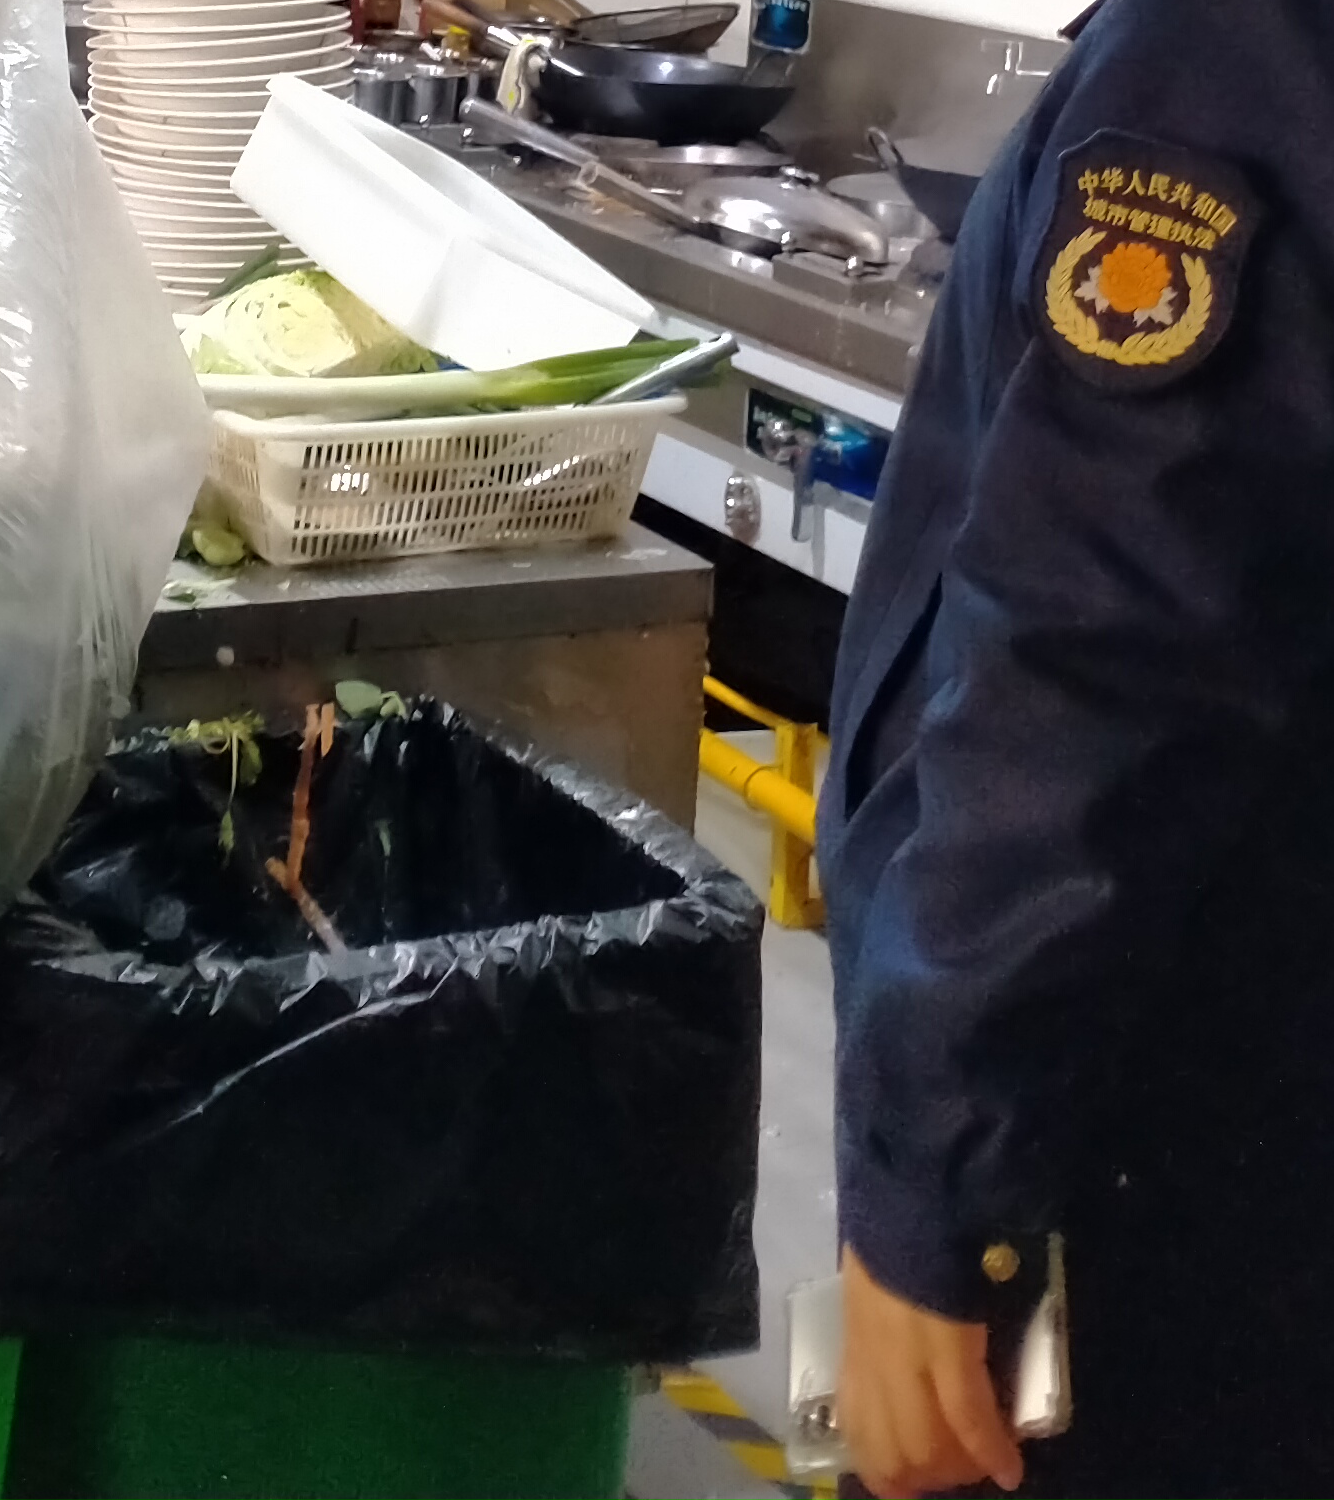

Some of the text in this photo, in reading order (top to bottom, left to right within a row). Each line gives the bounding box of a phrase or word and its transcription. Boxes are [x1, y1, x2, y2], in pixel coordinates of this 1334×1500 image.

[1078, 167, 1237, 237] 中华人民共和国
